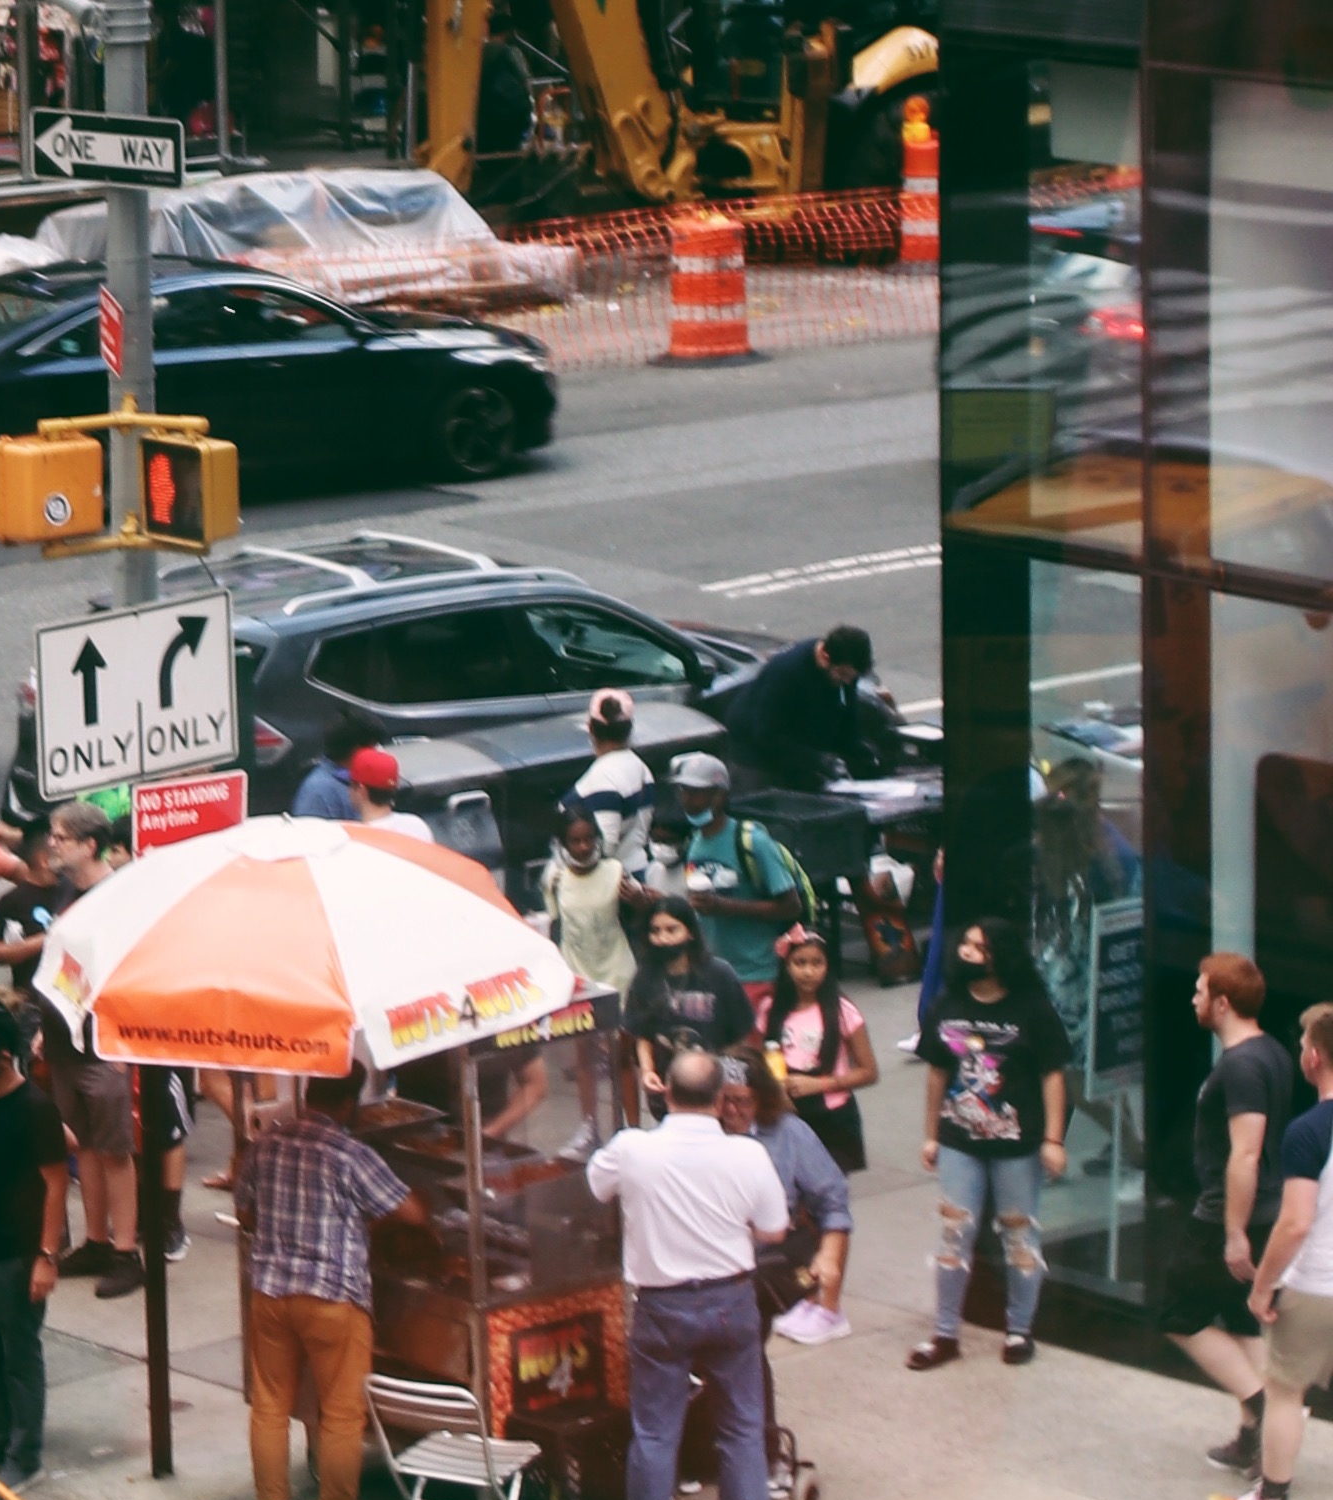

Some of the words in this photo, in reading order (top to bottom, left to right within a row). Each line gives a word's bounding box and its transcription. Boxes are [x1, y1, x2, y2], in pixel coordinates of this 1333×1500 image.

[52, 133, 96, 162] ONE
[119, 137, 169, 169] WAY
[48, 730, 134, 778] ONLY
[146, 710, 226, 757] ONLY
[139, 791, 162, 812] NO
[164, 781, 230, 809] STANDING
[140, 808, 199, 833] Anytime
[119, 1021, 331, 1056] www.nuts4nuts.com
